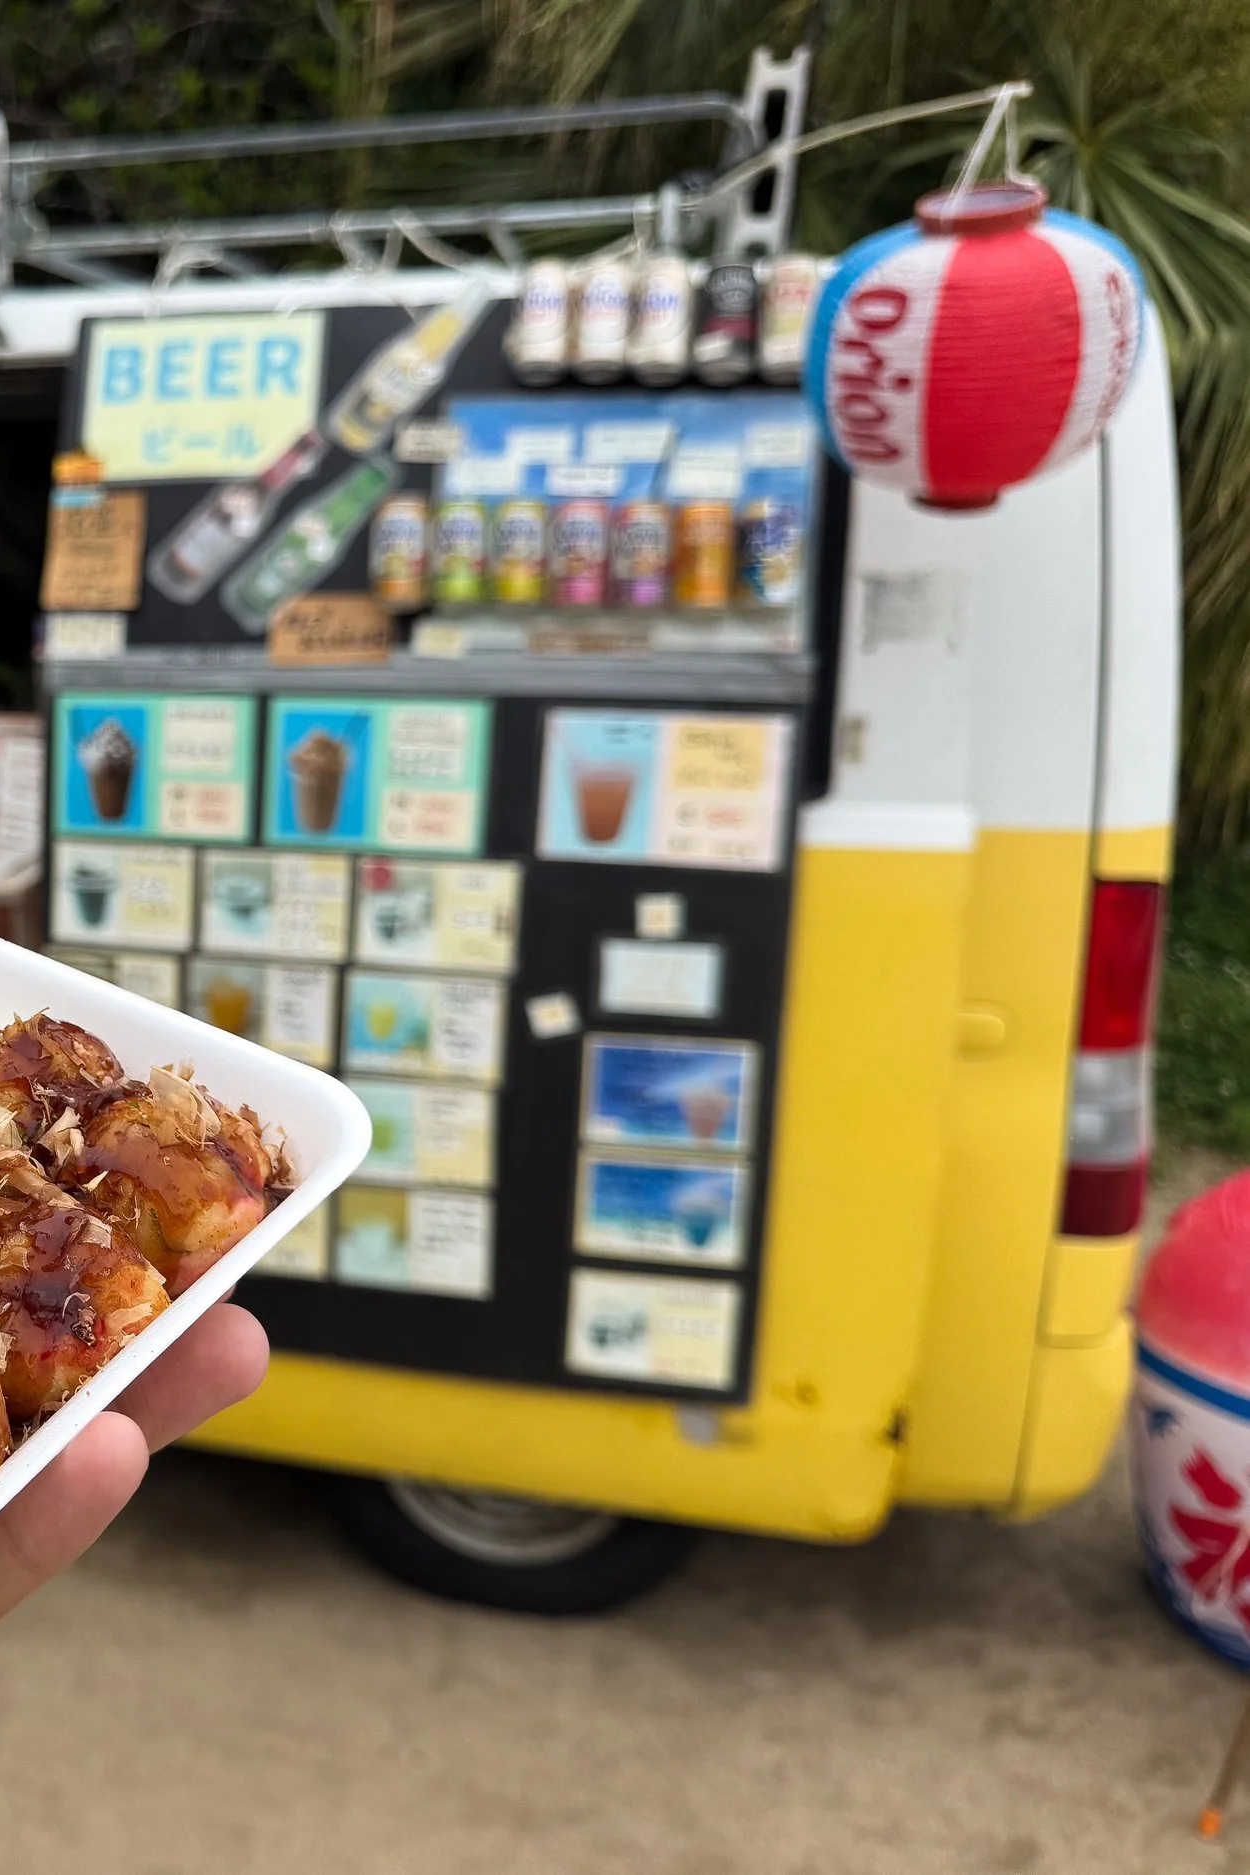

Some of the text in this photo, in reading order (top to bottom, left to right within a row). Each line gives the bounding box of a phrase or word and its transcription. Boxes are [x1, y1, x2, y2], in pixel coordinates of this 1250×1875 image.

[100, 332, 304, 405] BEER
[835, 286, 913, 466] Orion
[139, 425, 261, 468] ビール
